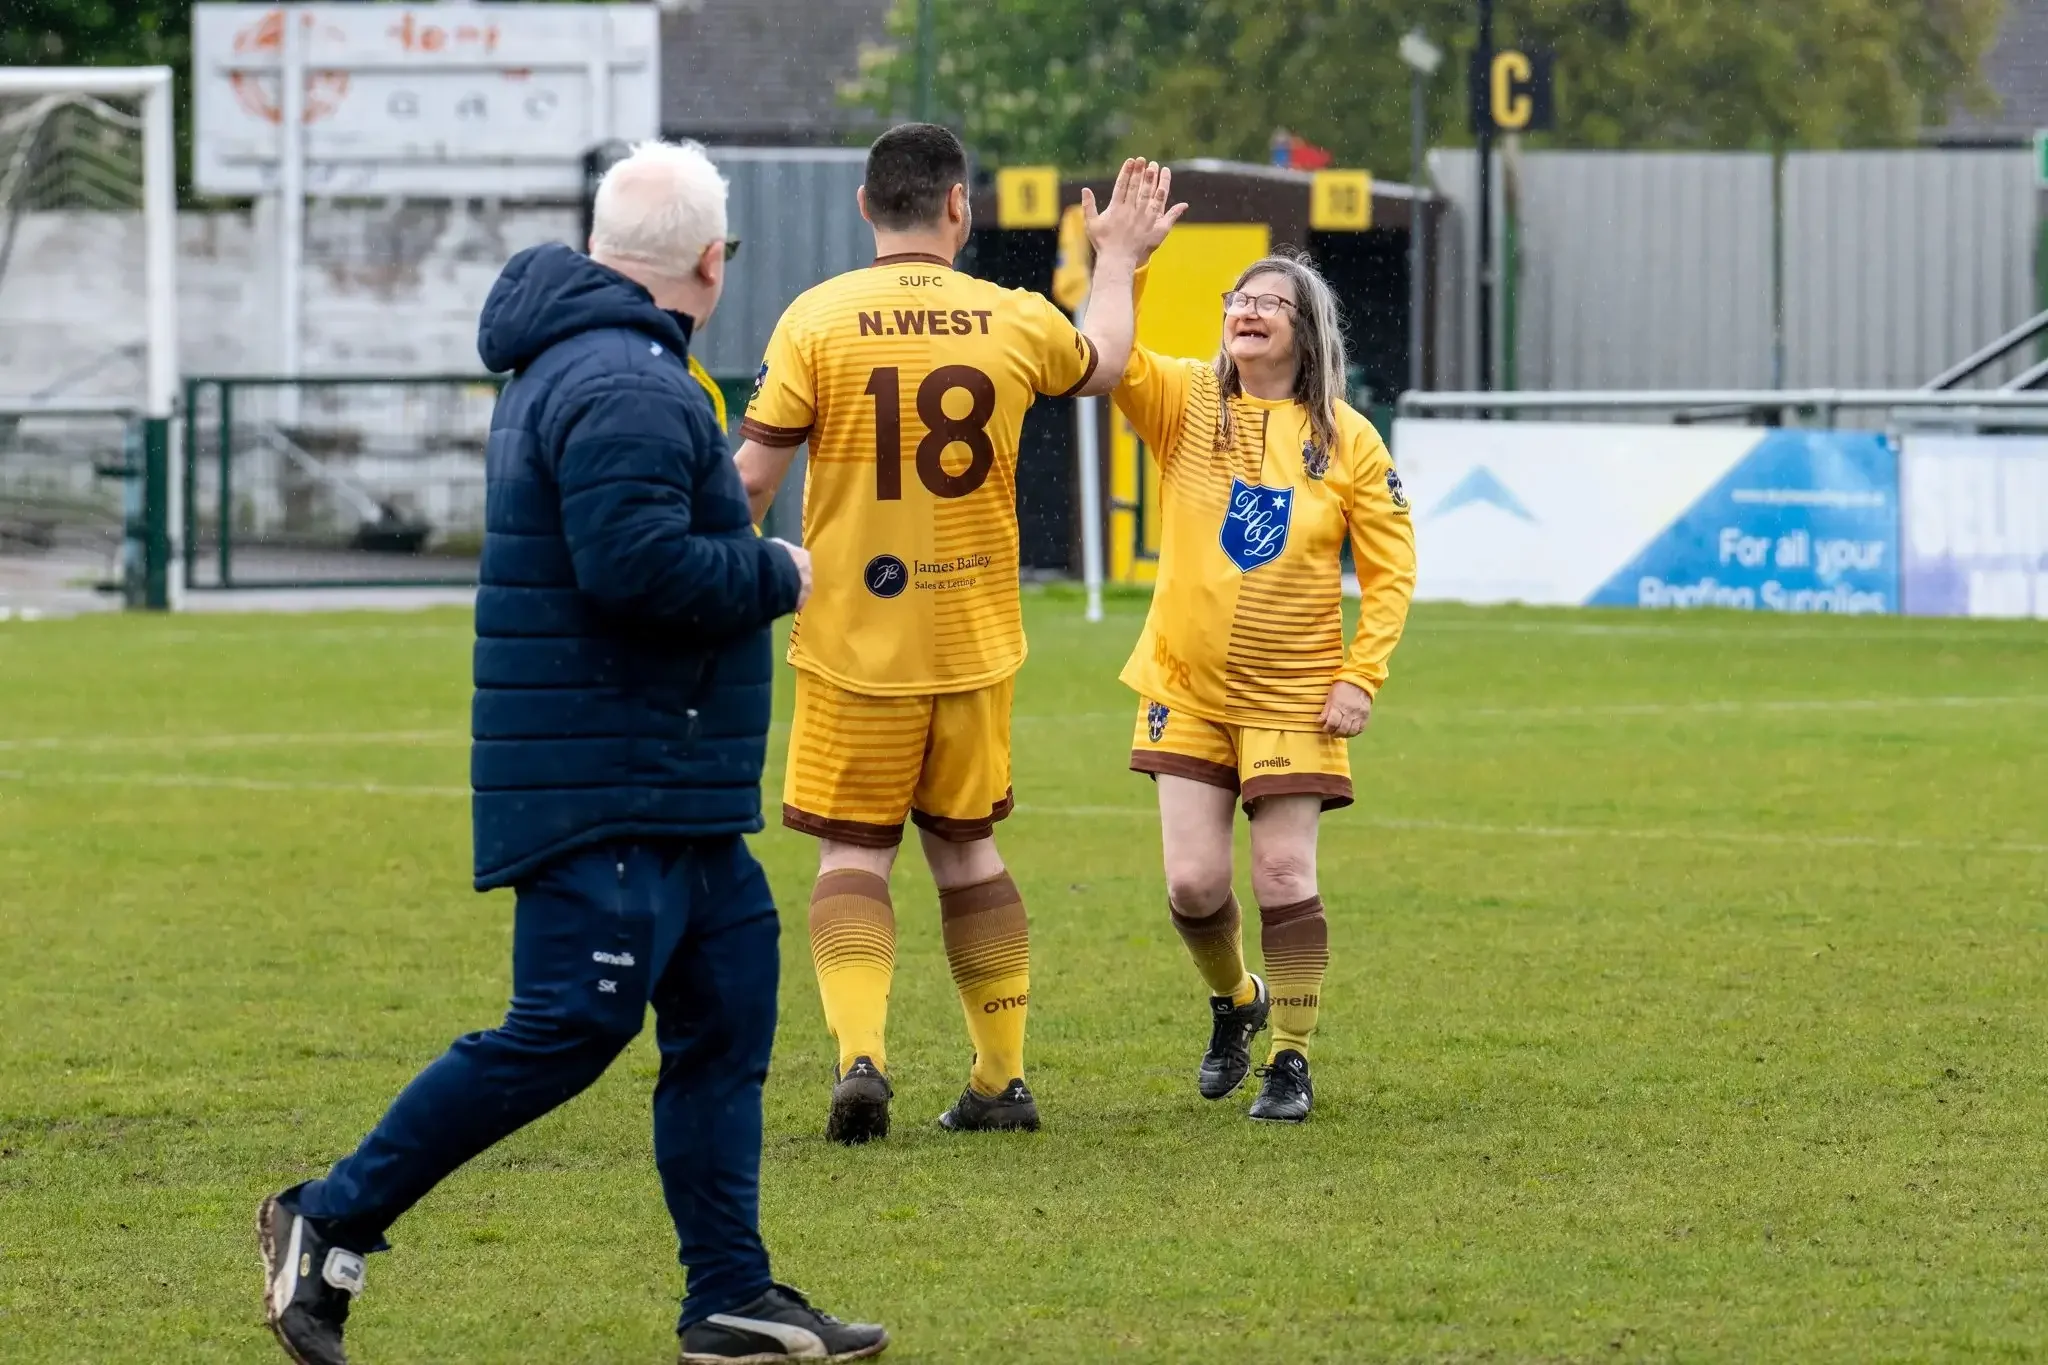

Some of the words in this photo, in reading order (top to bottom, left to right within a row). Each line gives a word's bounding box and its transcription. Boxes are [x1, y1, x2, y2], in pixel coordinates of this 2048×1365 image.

[1490, 50, 1533, 129] C
[899, 275, 943, 287] SUFC
[858, 309, 993, 337] N.WEST
[863, 364, 996, 501] 18
[913, 559, 955, 576] James
[956, 553, 992, 571] Bailey
[1718, 526, 1772, 568] For
[1775, 527, 1810, 568] all
[1814, 539, 1885, 584] your
[914, 580, 937, 591] Sales
[937, 580, 947, 590] &
[947, 576, 977, 590] Lettings
[1154, 632, 1192, 691] 1898
[597, 979, 618, 994] SK
